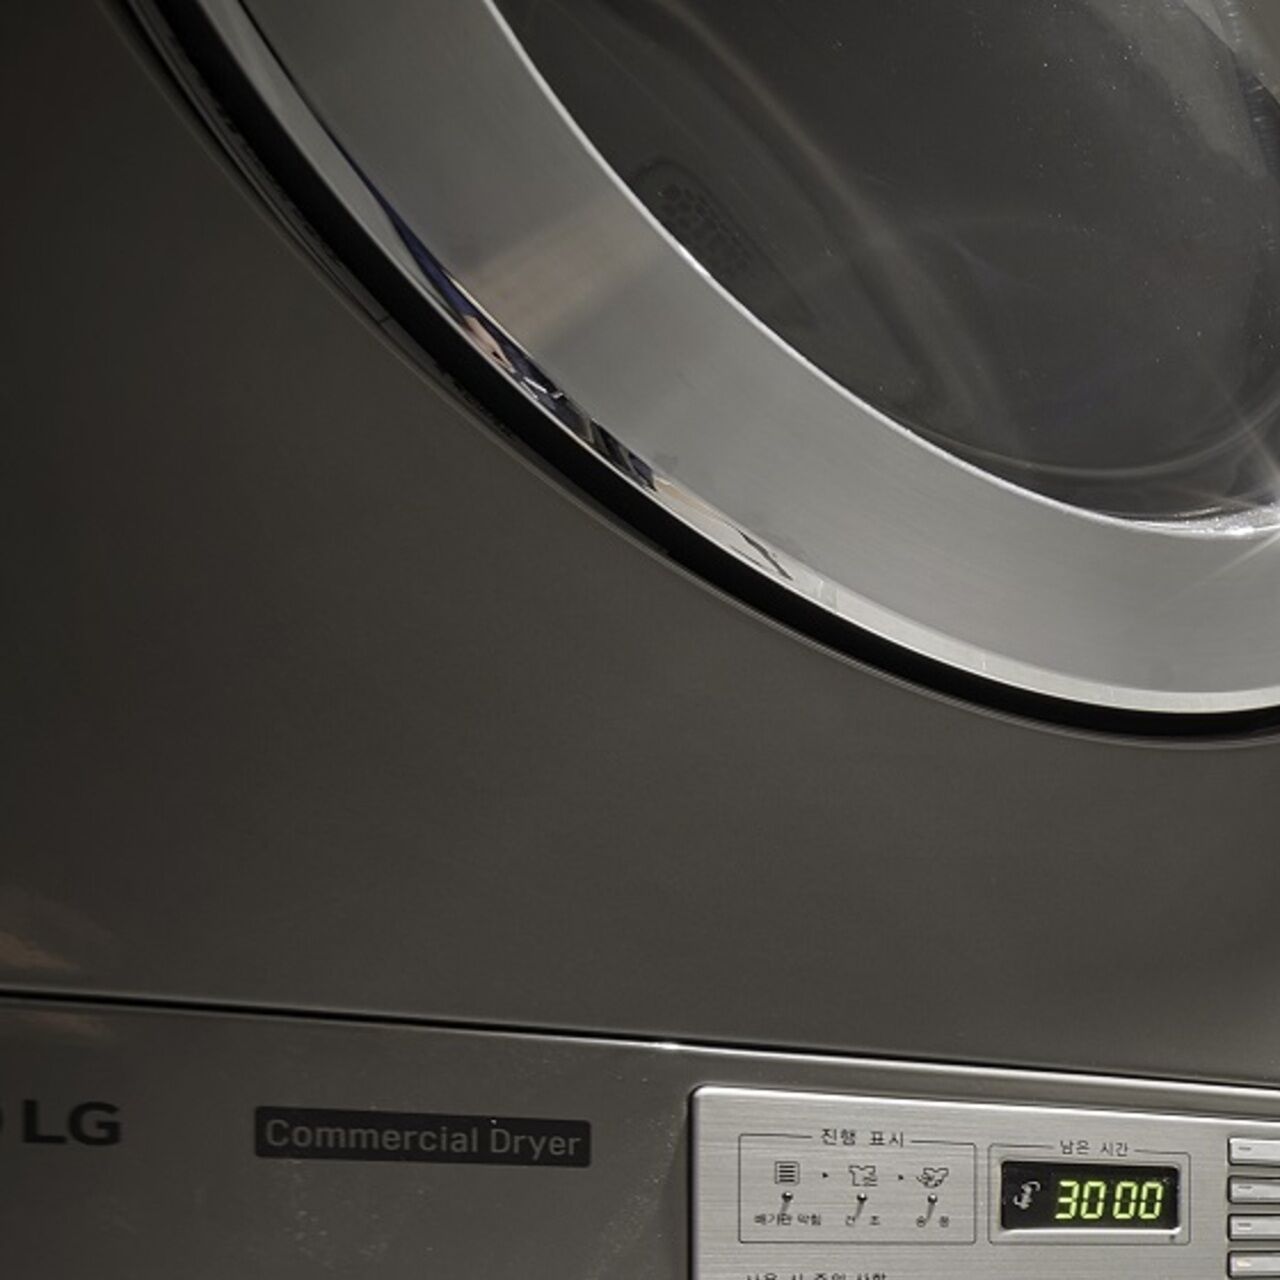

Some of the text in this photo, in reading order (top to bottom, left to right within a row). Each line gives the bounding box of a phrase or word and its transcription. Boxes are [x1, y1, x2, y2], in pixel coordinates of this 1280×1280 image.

[22, 1099, 122, 1145] LG
[266, 1119, 581, 1160] Commercial Dryer
[820, 1128, 904, 1147] 진행 표시
[1059, 1139, 1128, 1157] 남은 시간
